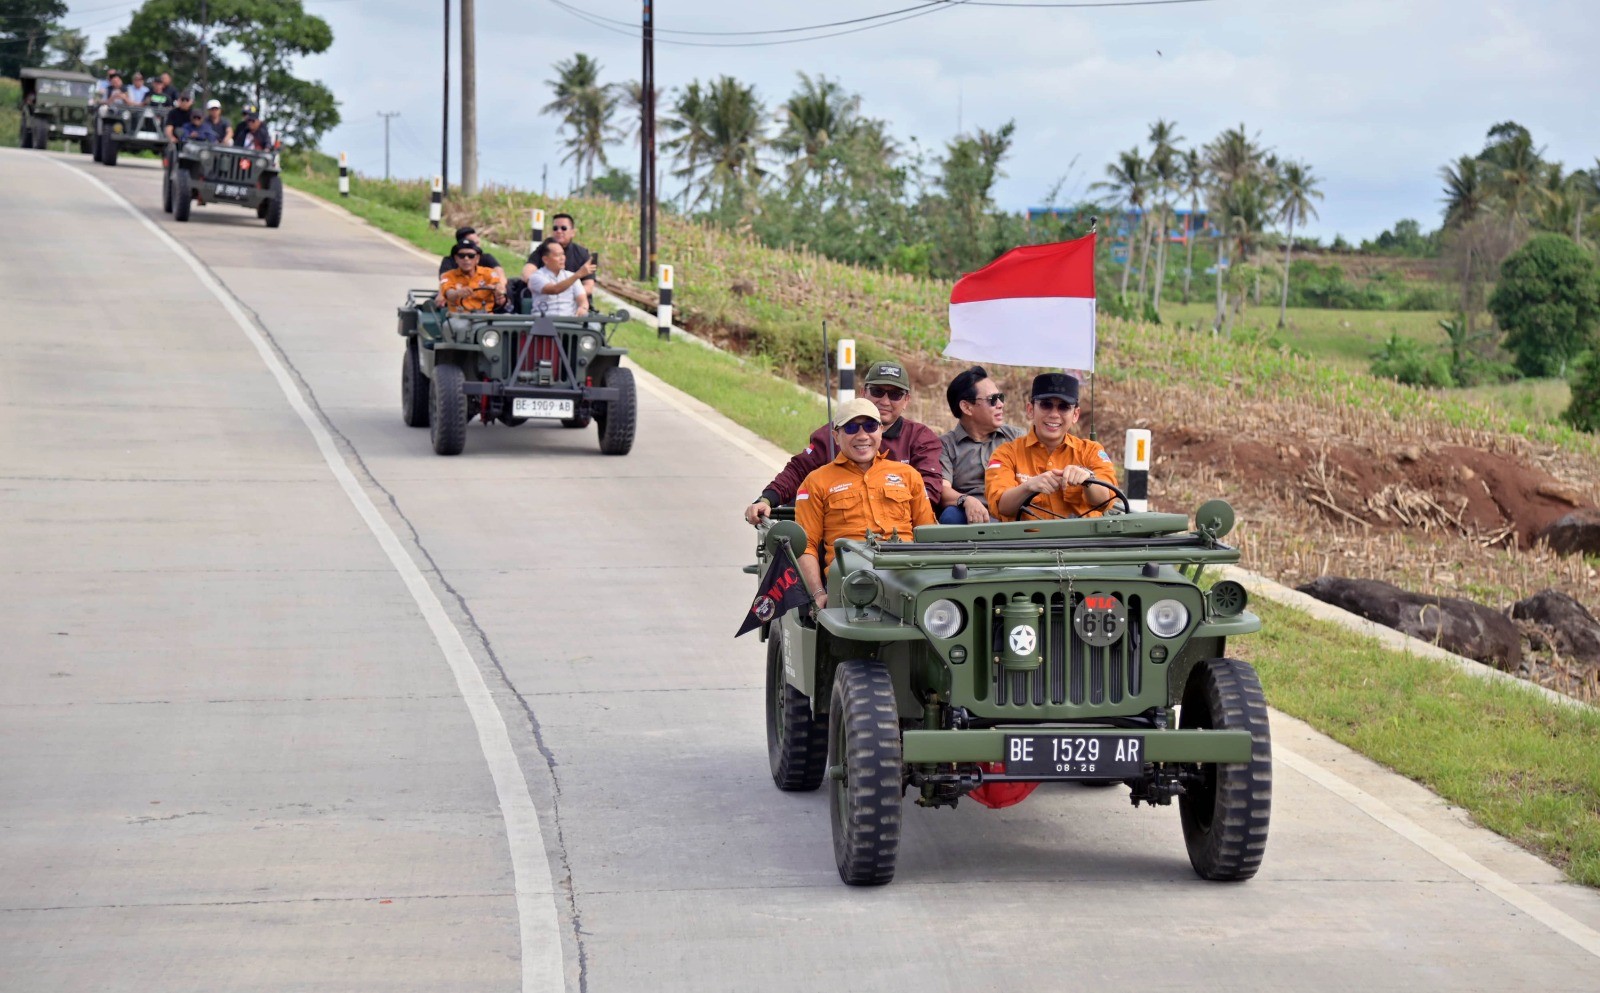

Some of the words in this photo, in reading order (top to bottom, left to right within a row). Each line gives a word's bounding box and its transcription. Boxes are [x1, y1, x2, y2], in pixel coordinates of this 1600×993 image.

[515, 400, 527, 410] BE
[559, 402, 571, 412] AB
[768, 567, 798, 602] WLC
[1085, 596, 1117, 609] WLC
[1010, 738, 1034, 762] BE
[1052, 738, 1100, 762] 1529
[1114, 738, 1140, 763] AR
